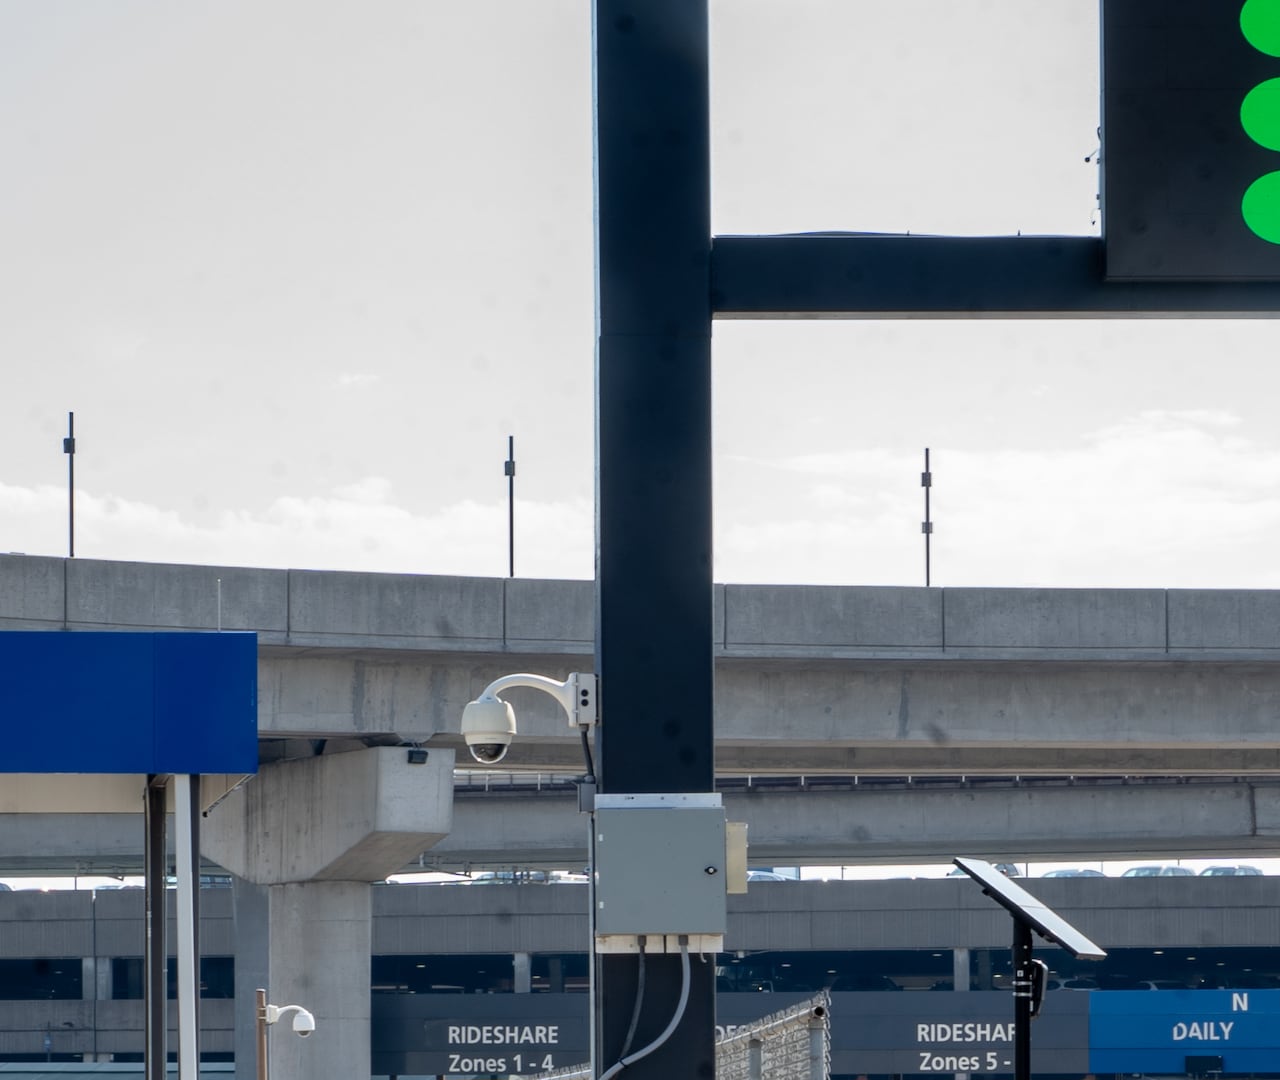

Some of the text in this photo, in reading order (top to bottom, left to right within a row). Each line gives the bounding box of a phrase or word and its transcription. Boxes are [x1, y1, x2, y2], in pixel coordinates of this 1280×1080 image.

[448, 1025, 559, 1044] RIDESHARE
[1173, 1022, 1234, 1041] DAILY
[449, 1054, 507, 1072] Zones
[513, 1054, 522, 1072] 1
[541, 1053, 554, 1072] 4
[919, 1052, 980, 1071] Zones
[986, 1051, 998, 1071] 5
